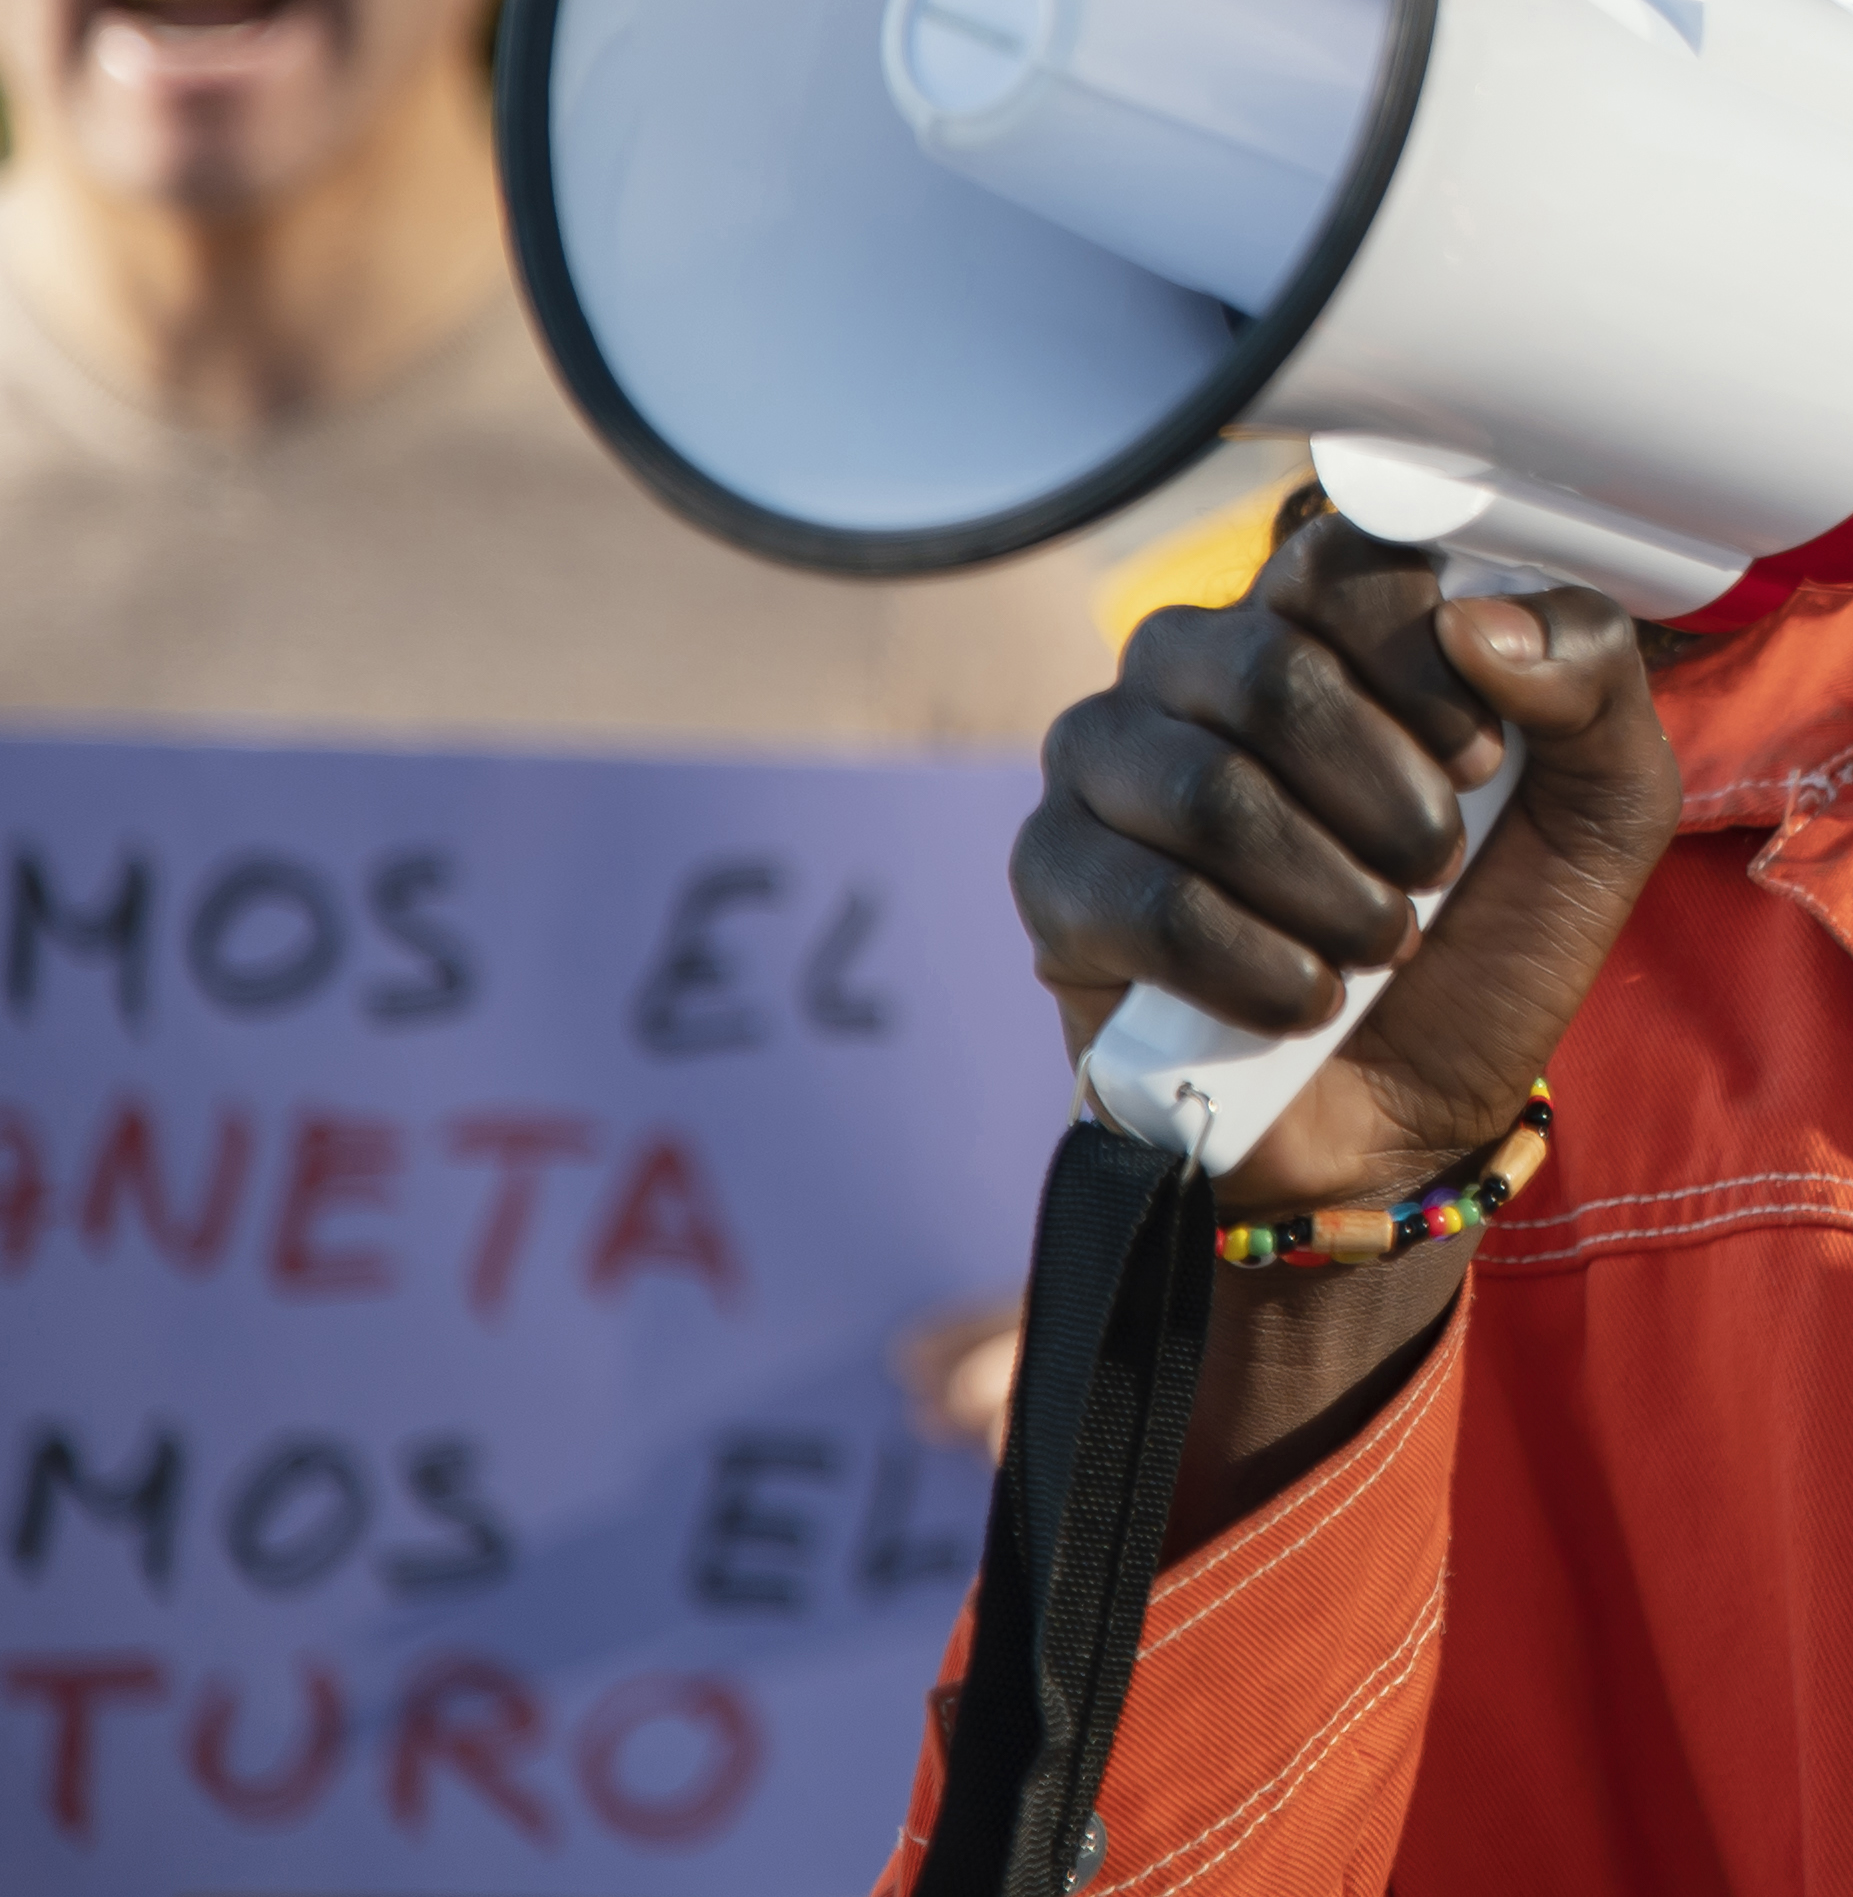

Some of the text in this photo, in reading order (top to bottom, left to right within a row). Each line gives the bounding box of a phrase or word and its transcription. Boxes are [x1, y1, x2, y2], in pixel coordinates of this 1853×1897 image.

[3, 843, 900, 1057] MOS EL
[12, 1421, 965, 1618] MOS EL
[2, 1648, 768, 1850] TURO
